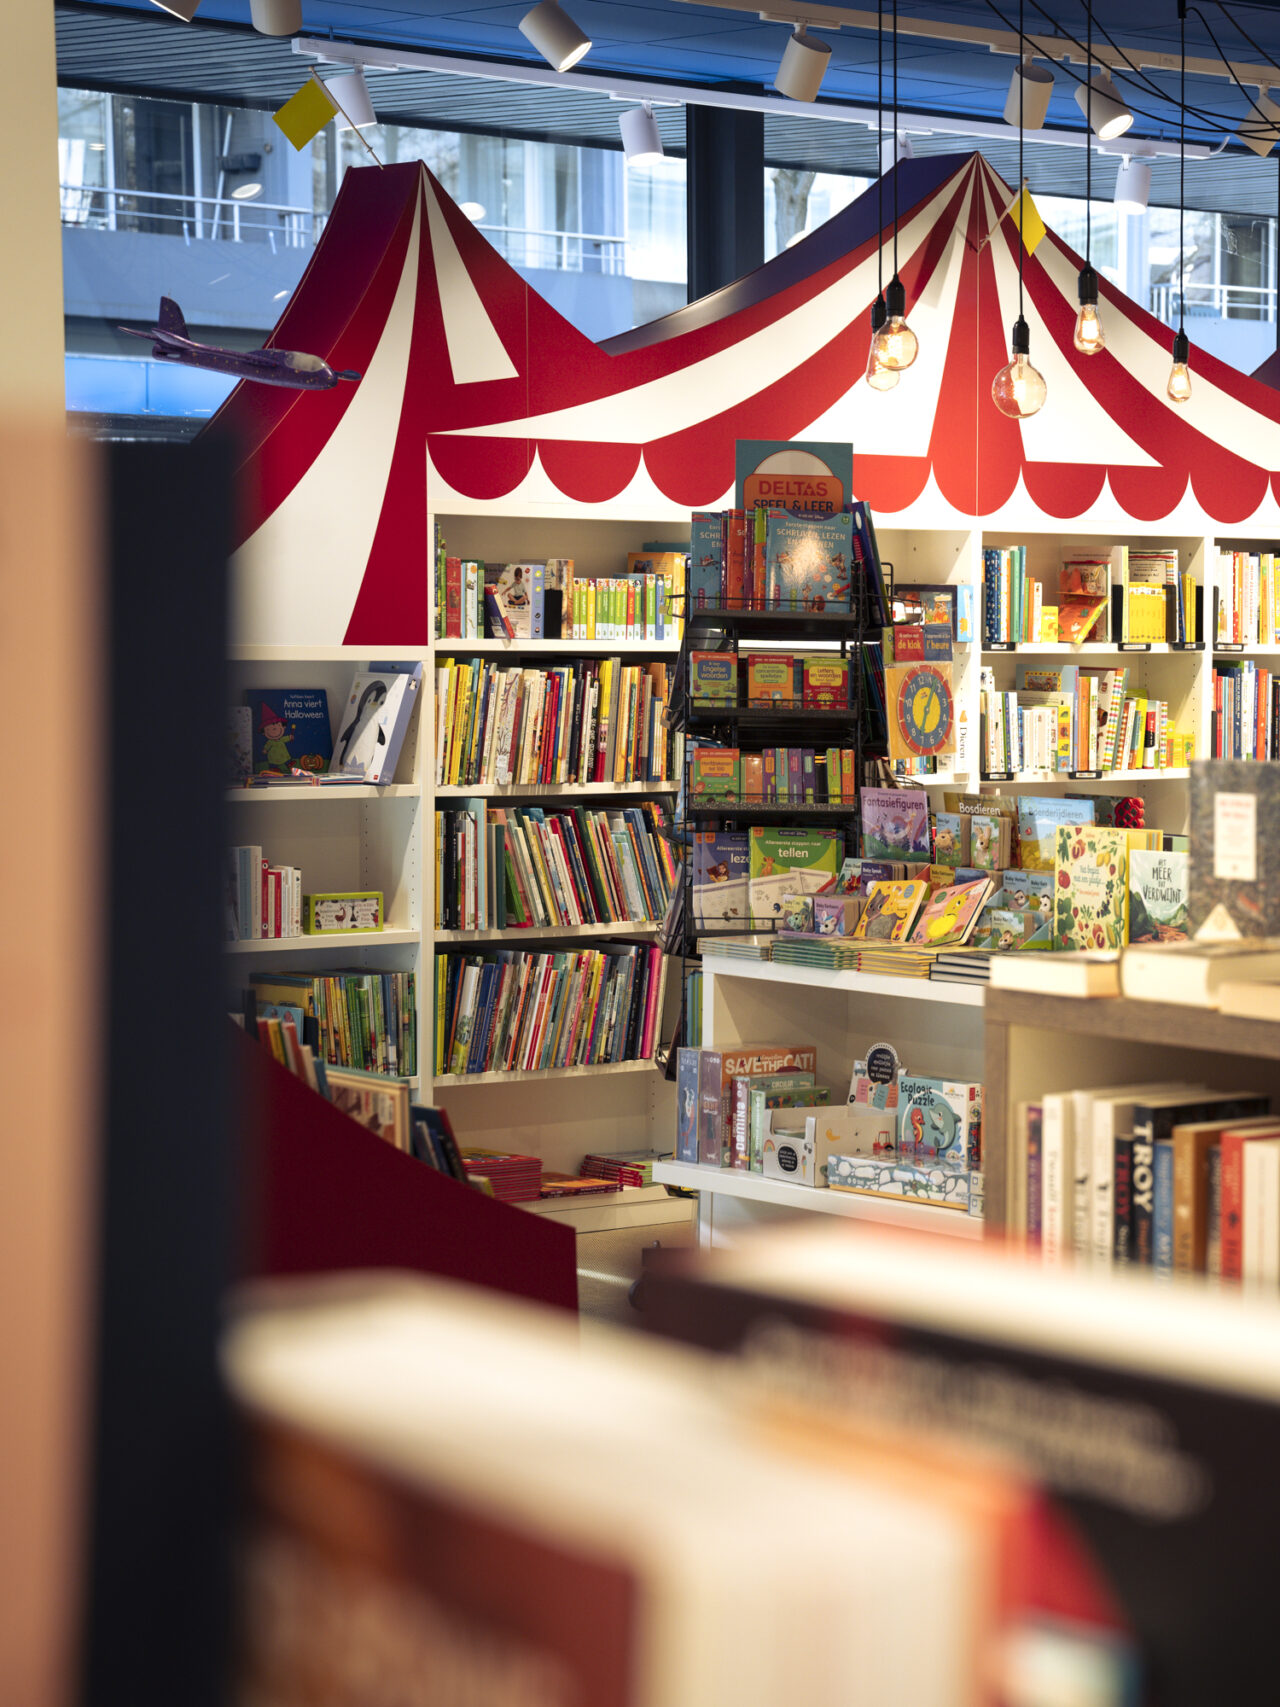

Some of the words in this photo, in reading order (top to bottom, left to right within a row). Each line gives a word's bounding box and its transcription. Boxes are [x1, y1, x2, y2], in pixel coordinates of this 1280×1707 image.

[758, 480, 828, 497] DELTAS
[804, 500, 834, 513] LEER
[822, 531, 846, 541] LEZEN
[907, 639, 922, 649] klok
[284, 699, 303, 708] Anna
[304, 699, 322, 708] viert
[285, 710, 324, 719] Halloween
[862, 795, 925, 812] Fantasiefiguren
[959, 802, 1001, 816] Bosdieren
[1028, 806, 1084, 820] Boerderijdieren
[778, 848, 809, 858] tellen
[1152, 867, 1173, 882] MEER
[725, 1057, 761, 1075] SAVE
[761, 1060, 783, 1072] THE
[783, 1053, 814, 1071] CAT!
[900, 1081, 933, 1096] Ecologic
[907, 1095, 935, 1107] Puzzle
[1133, 1120, 1154, 1214] TROY
[1115, 1153, 1130, 1216] TROY
